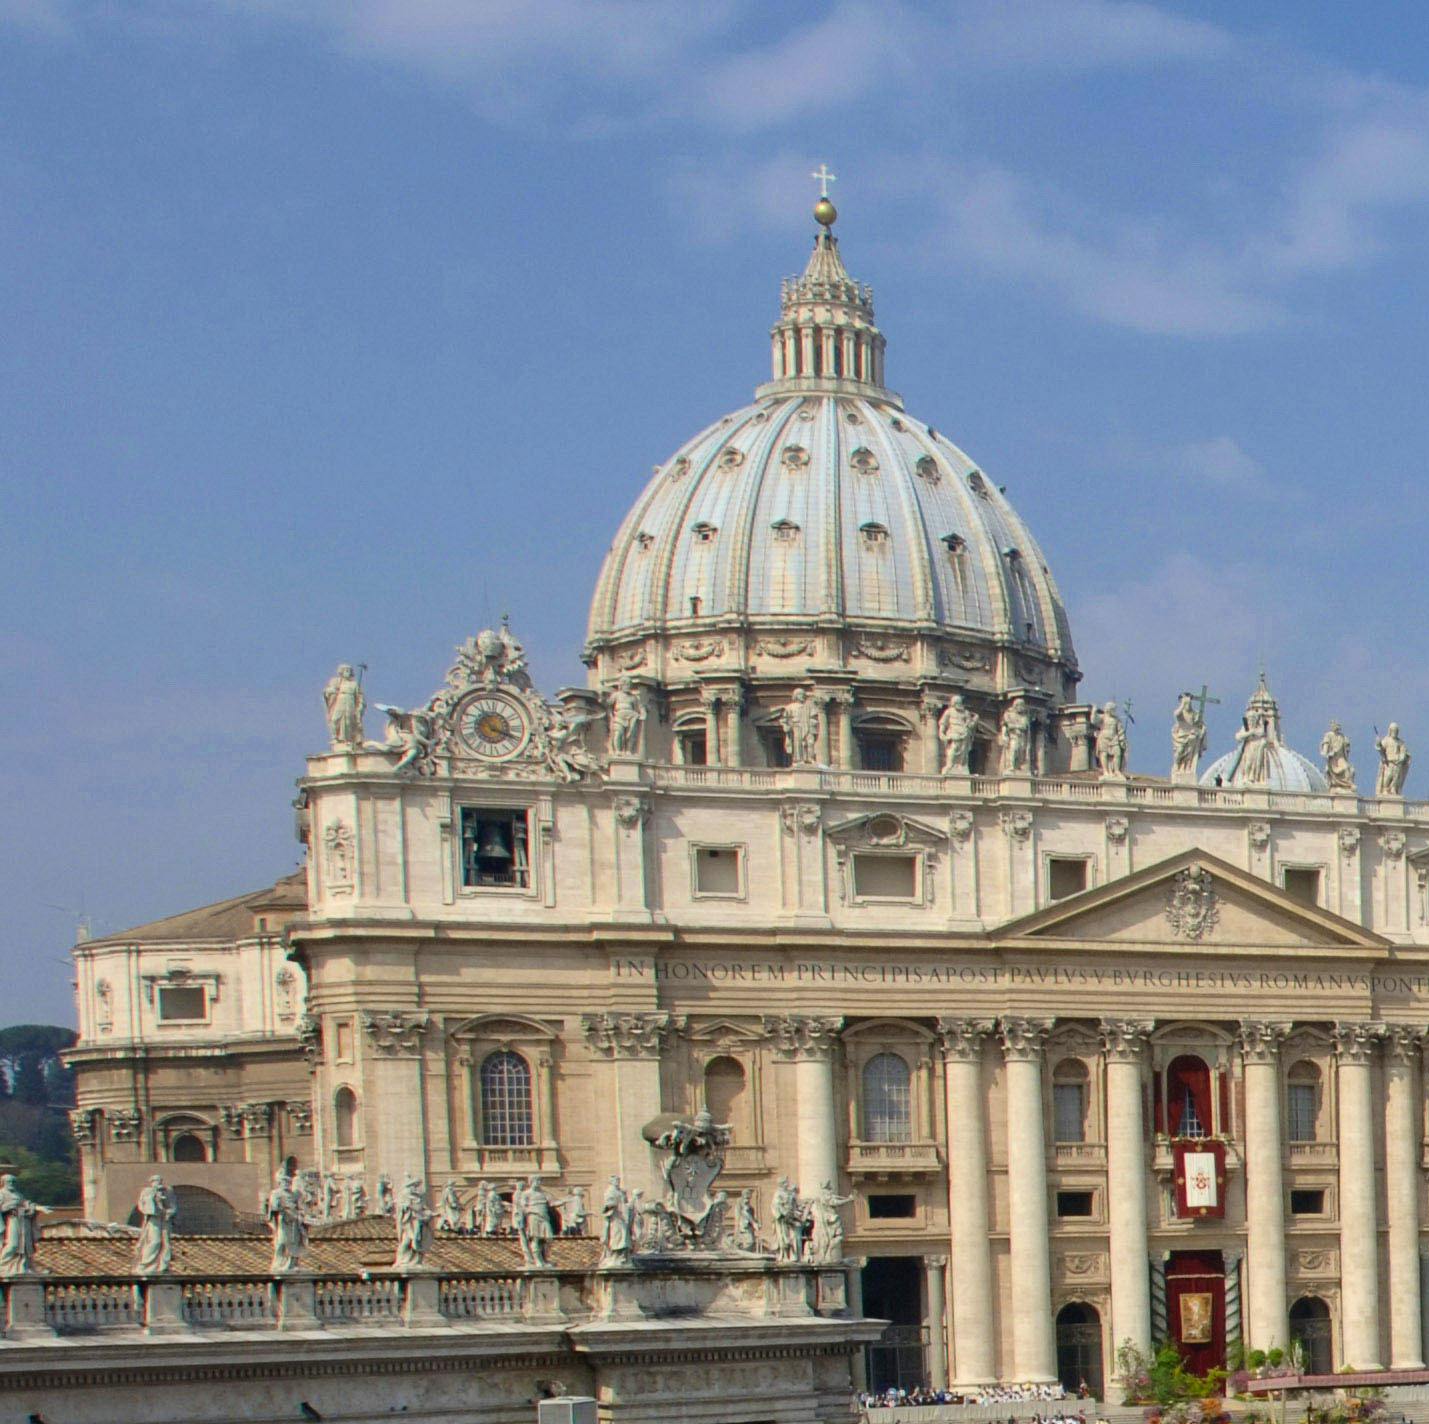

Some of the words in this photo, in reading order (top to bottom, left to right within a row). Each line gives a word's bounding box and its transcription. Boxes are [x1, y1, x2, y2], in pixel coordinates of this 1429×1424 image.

[614, 959, 644, 977] IN
[655, 961, 785, 982] HONOREM
[797, 963, 922, 983] PRINCIPIS
[929, 965, 1000, 984] APOST
[1010, 967, 1087, 986] PAVLVS
[1113, 969, 1252, 988] BVRGHESIVS
[1259, 973, 1369, 991] ROMANVS
